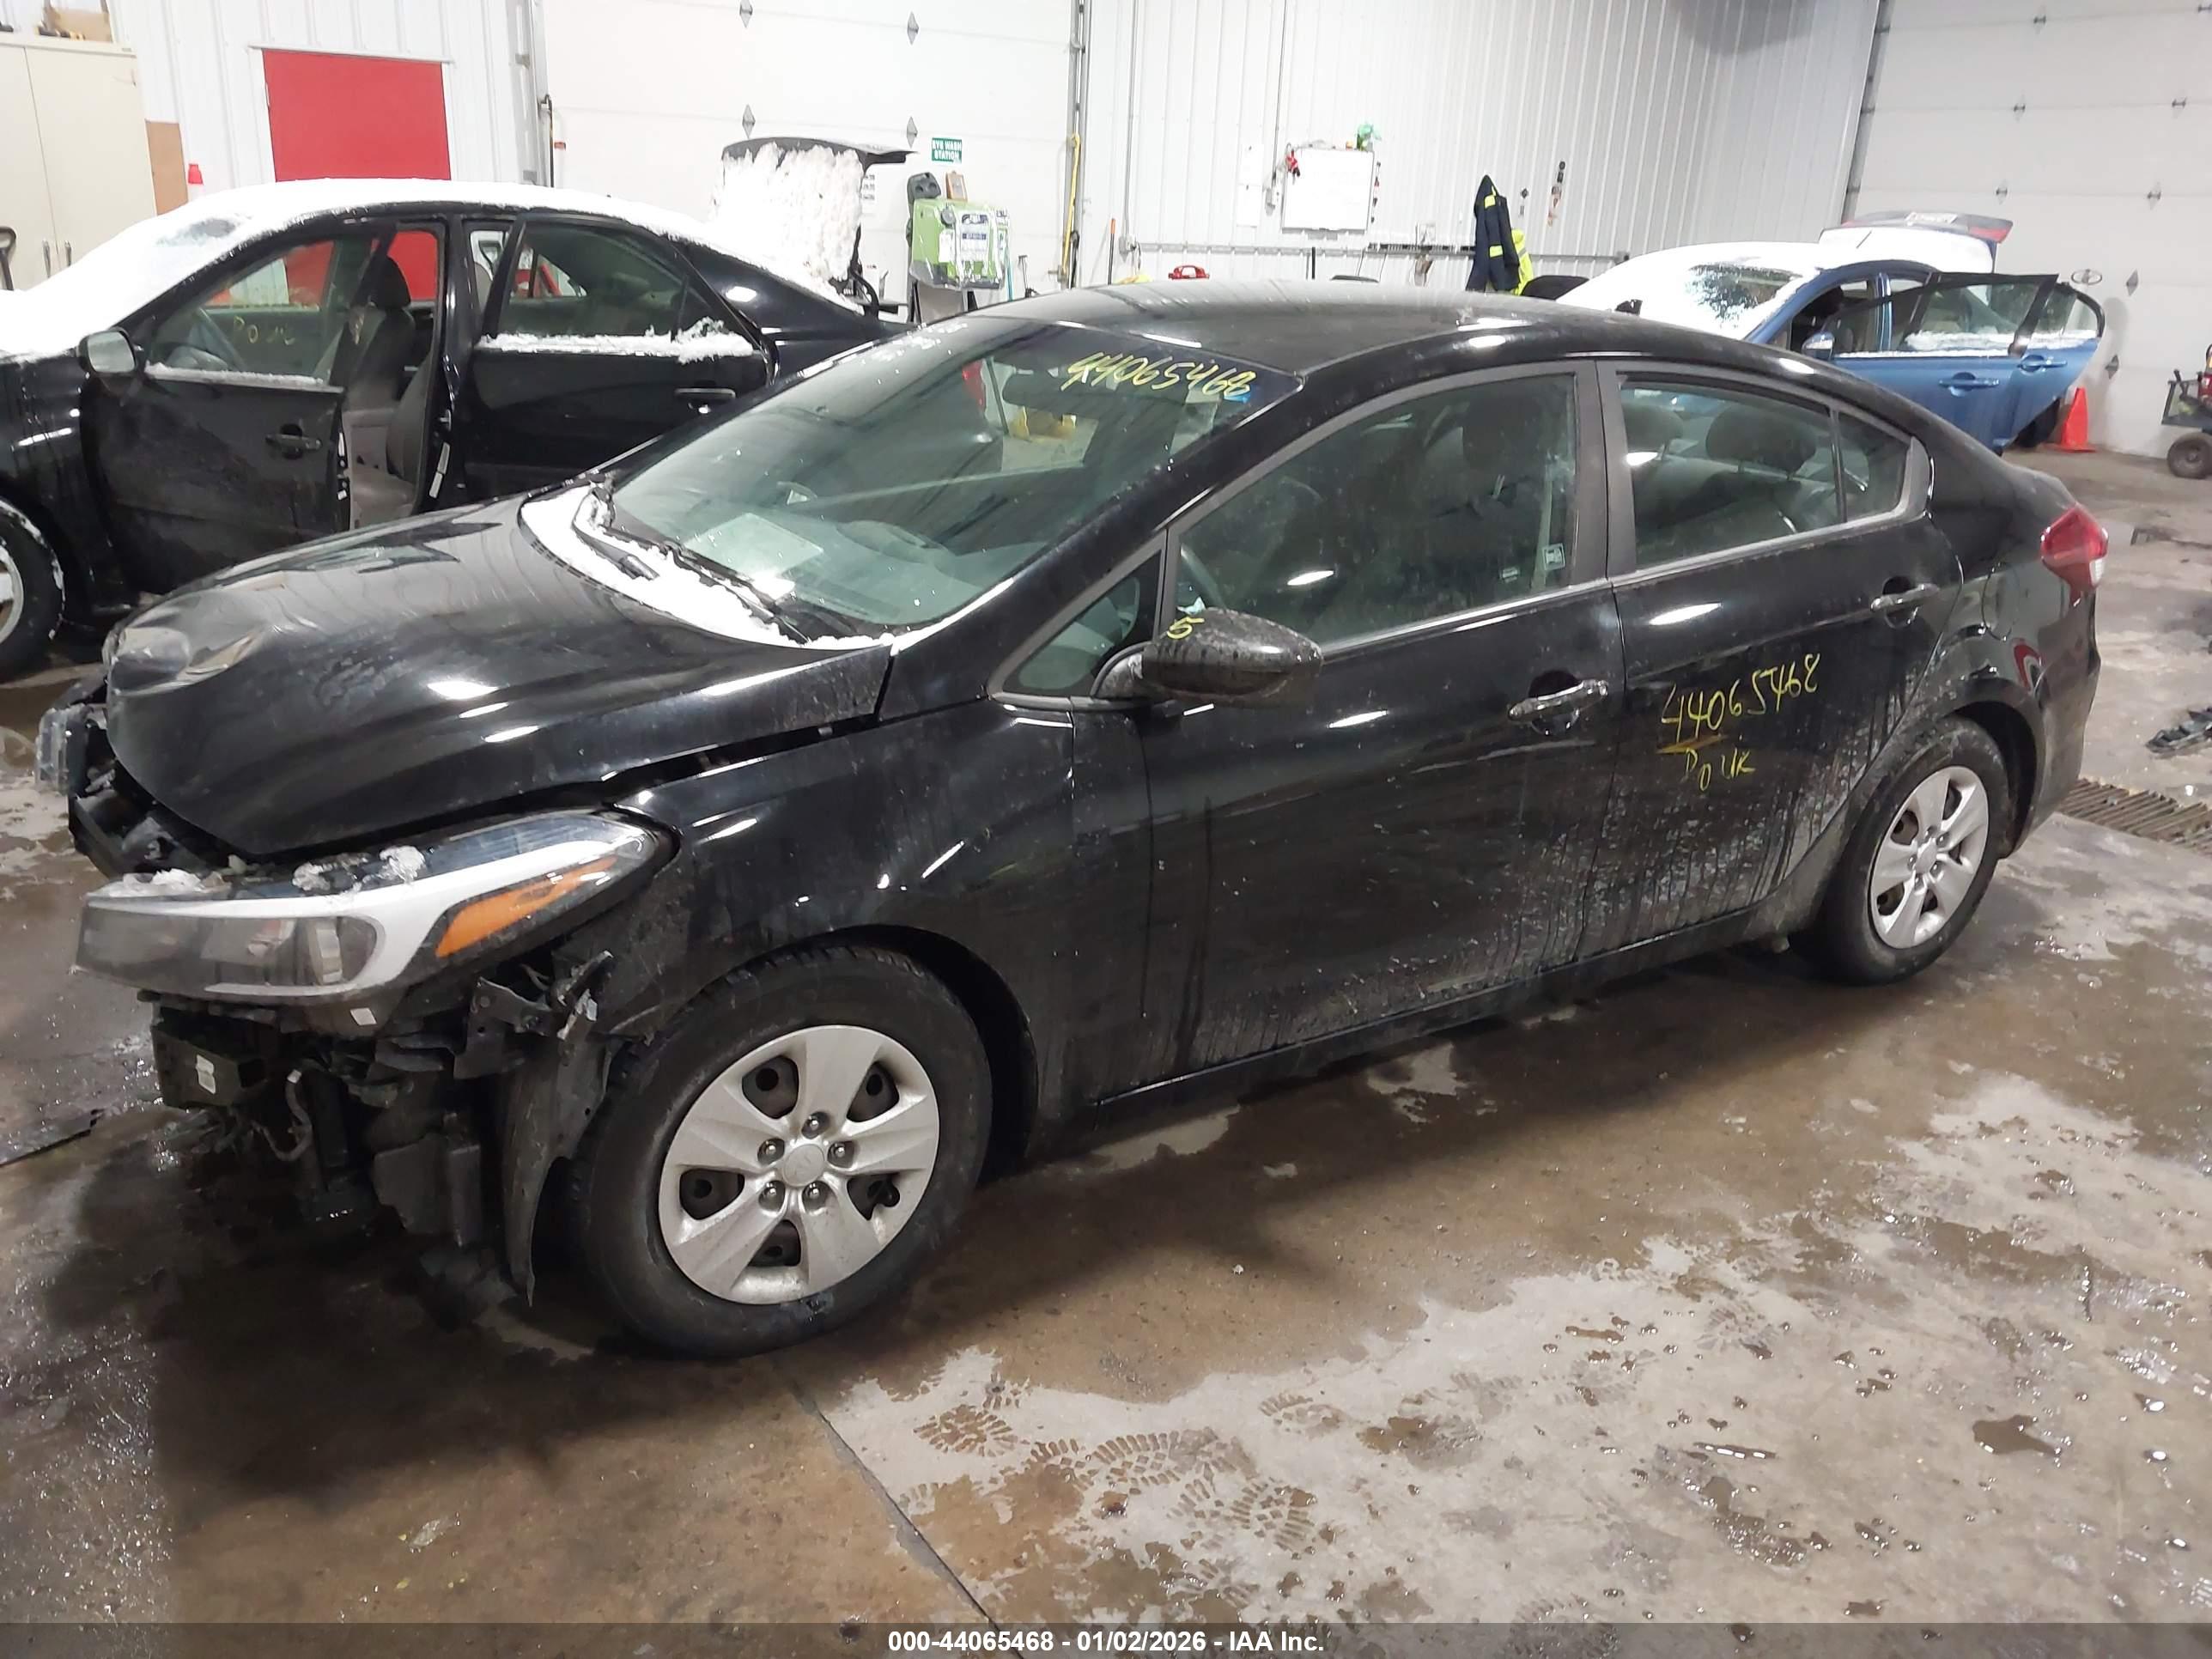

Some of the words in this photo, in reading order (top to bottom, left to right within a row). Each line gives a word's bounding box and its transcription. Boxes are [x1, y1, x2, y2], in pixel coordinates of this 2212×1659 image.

[933, 140, 944, 149] EYE
[945, 141, 962, 151] WASH
[934, 149, 959, 161] STATION
[1060, 351, 1257, 396] 44065468
[1661, 653, 1821, 743] 44065468
